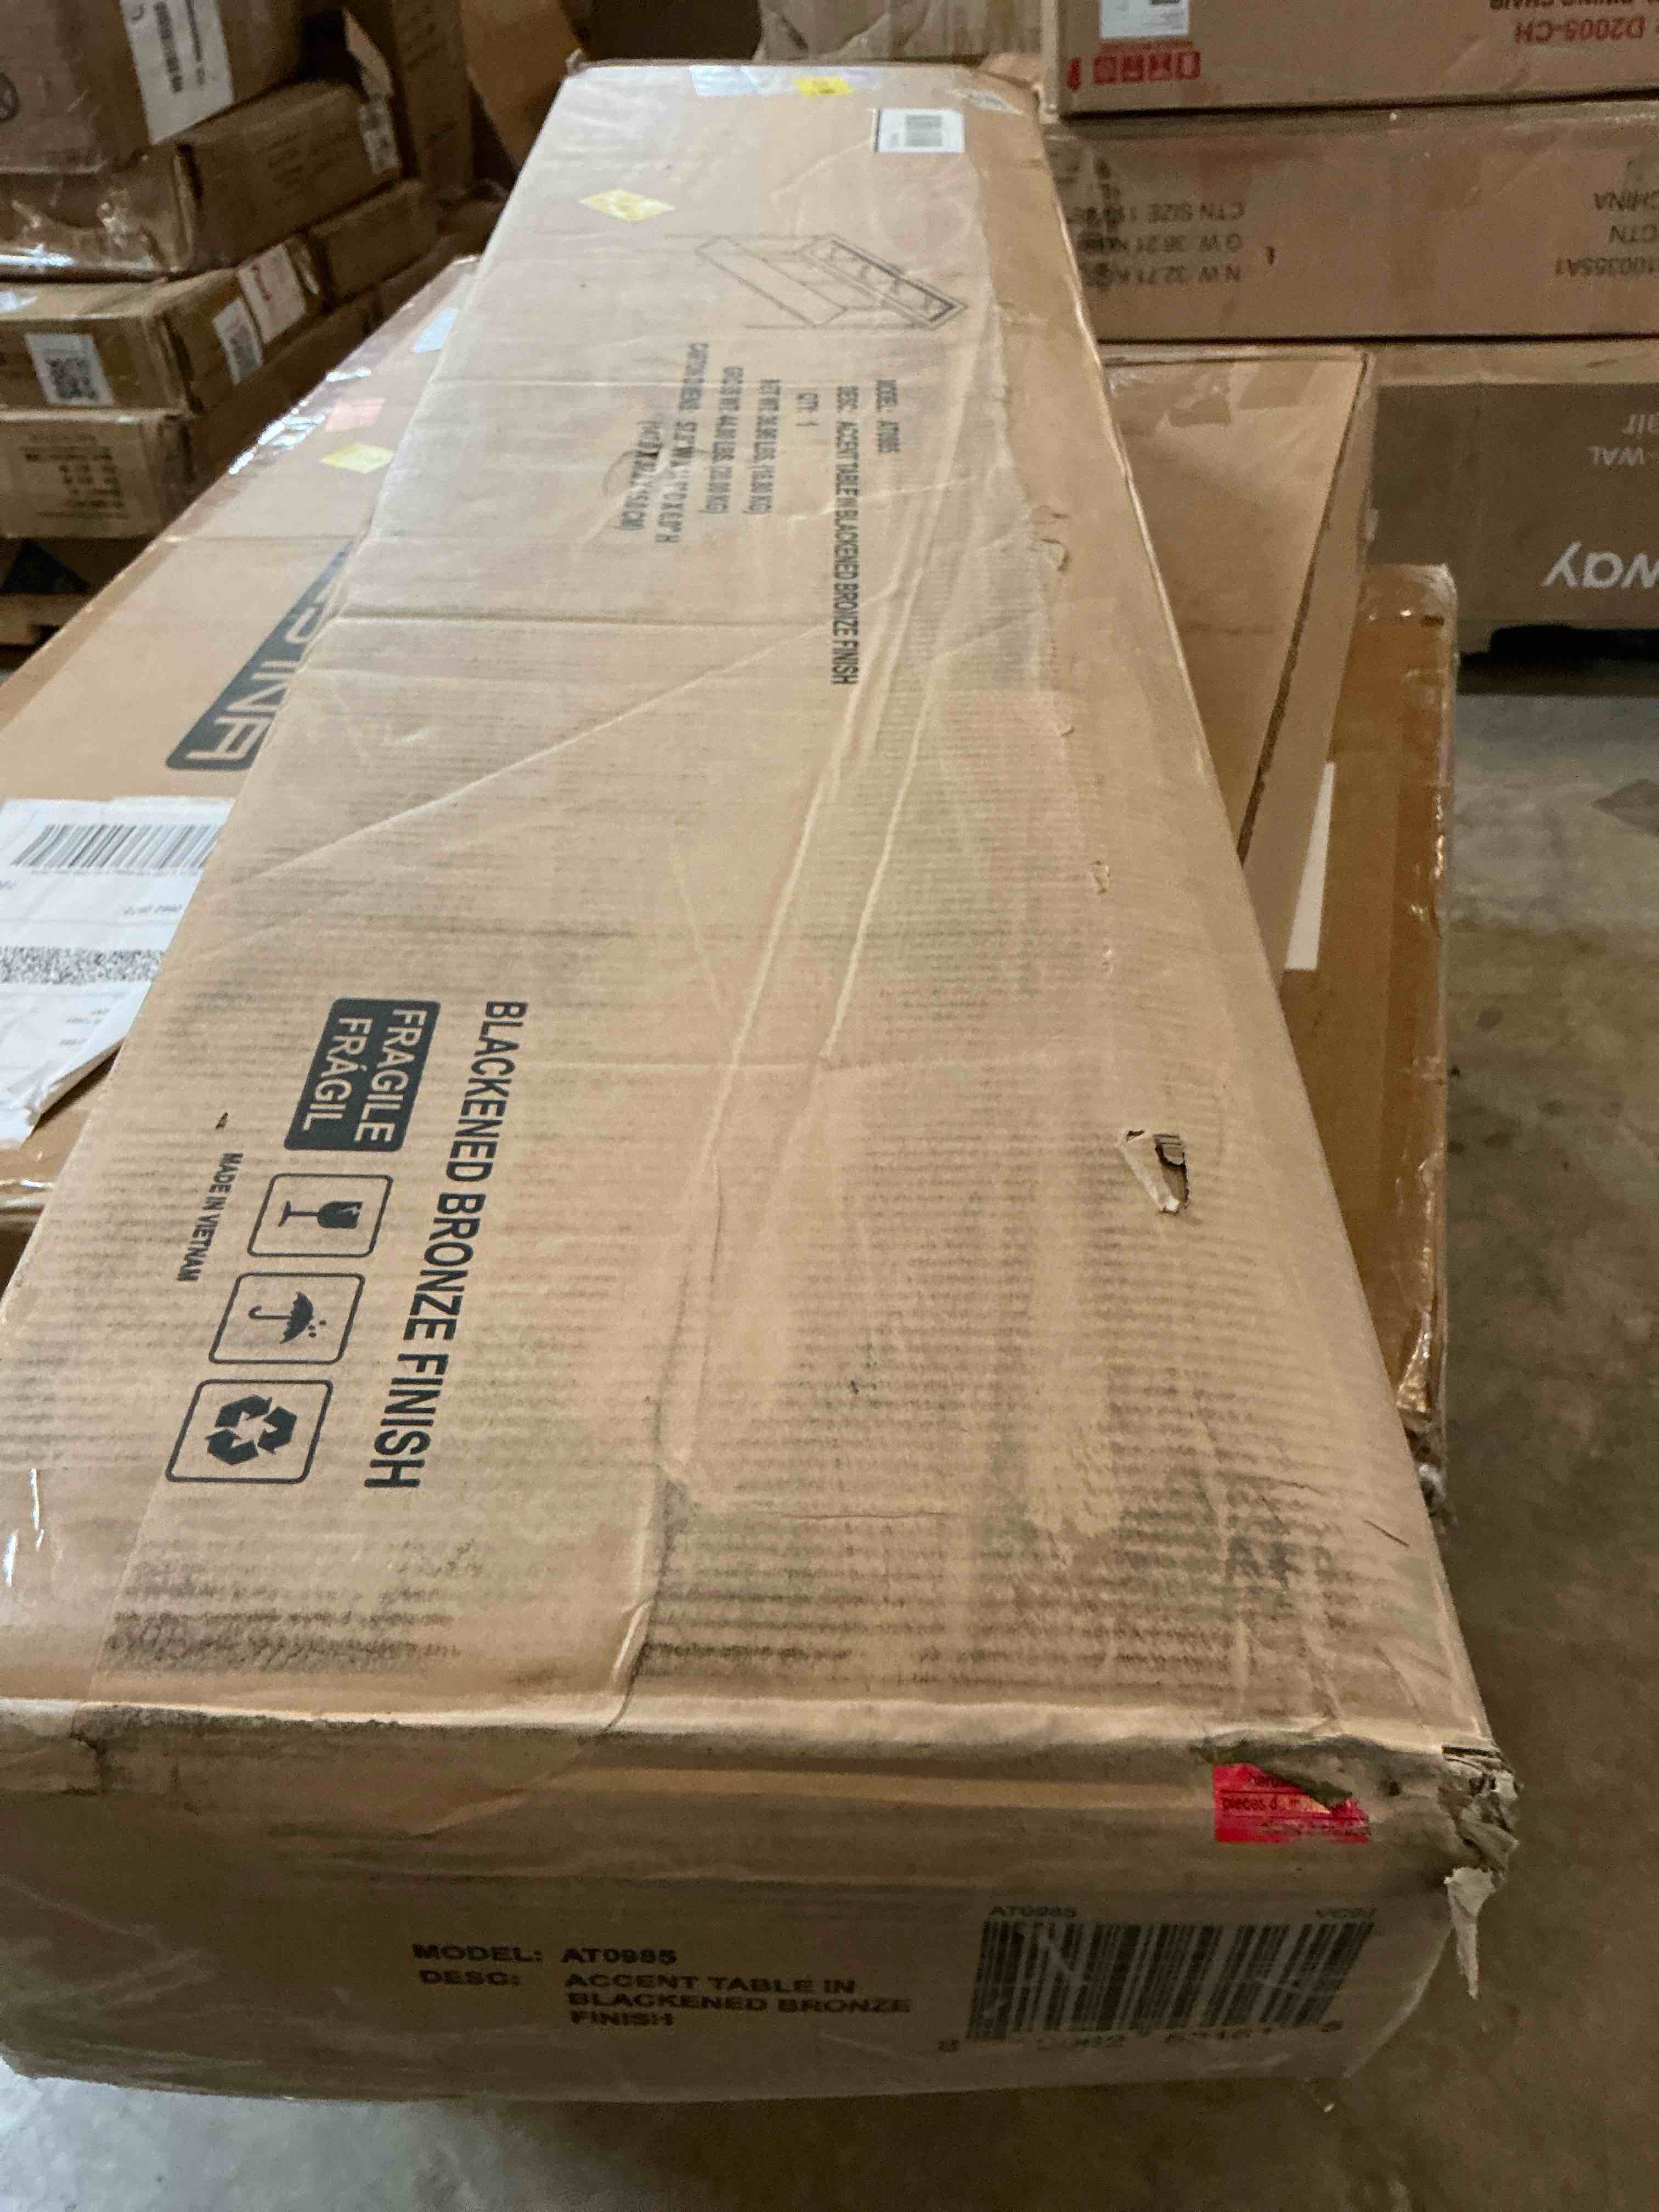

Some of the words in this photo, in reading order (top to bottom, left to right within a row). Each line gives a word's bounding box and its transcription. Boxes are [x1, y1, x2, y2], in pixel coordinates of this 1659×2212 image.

[835, 421, 859, 459] ACCENT
[835, 462, 859, 494] TABLE
[833, 509, 860, 580] BLACKENED
[832, 583, 859, 636] BRONZE
[830, 640, 860, 685] FINISH
[302, 1017, 373, 1132] FRÁGIL
[355, 1008, 428, 1144] FRAGILE
[445, 1000, 528, 1183] BLACKENED
[209, 1152, 244, 1193] MADE
[202, 1196, 227, 1210] IN
[177, 1213, 221, 1282] VIETNAM
[403, 1192, 487, 1341] BRONZE
[363, 1352, 450, 1489] FINISH
[412, 1943, 543, 1963] MODEL:
[419, 1970, 521, 1988] DESC:
[564, 1974, 697, 1990] ACCENT
[708, 1977, 817, 1994] TABLE
[823, 1978, 856, 1995] IN
[567, 1992, 766, 2013] BLACKENED
[776, 1997, 913, 2014] BRONZE
[571, 2010, 674, 2028] FINISH
